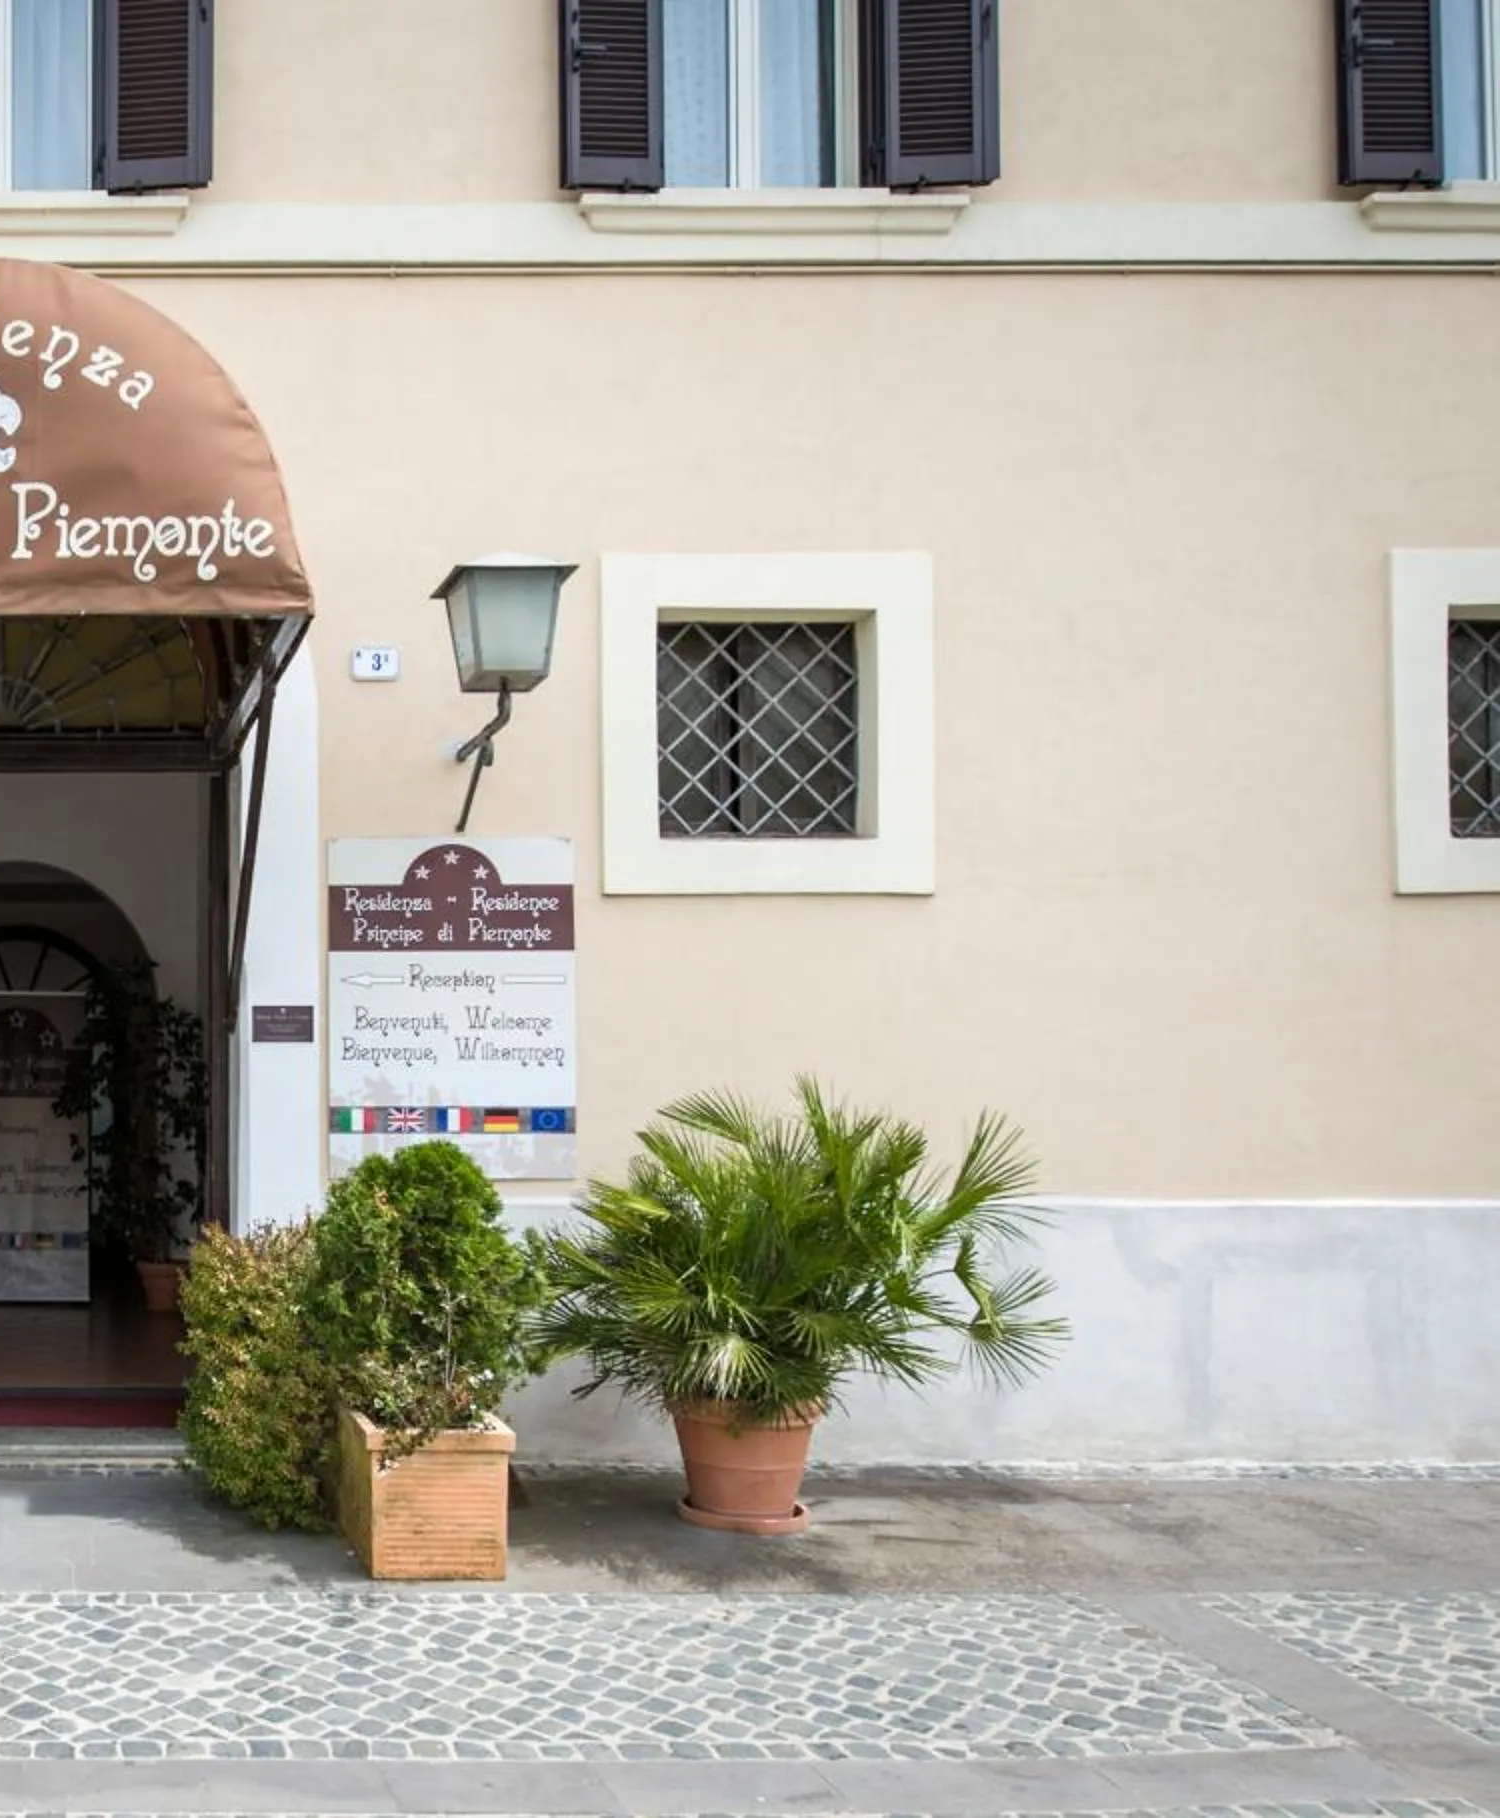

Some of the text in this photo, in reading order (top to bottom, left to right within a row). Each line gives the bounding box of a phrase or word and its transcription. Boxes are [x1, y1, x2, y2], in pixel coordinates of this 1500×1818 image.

[10, 481, 276, 581] Piemonte
[343, 886, 433, 918] Residenza
[469, 886, 560, 918] Residence
[353, 917, 553, 948] Principe di Piemonte
[408, 963, 496, 994] Reception
[354, 1005, 553, 1037] Benvenuti, Welcome
[341, 1036, 438, 1067] Bienvenue,
